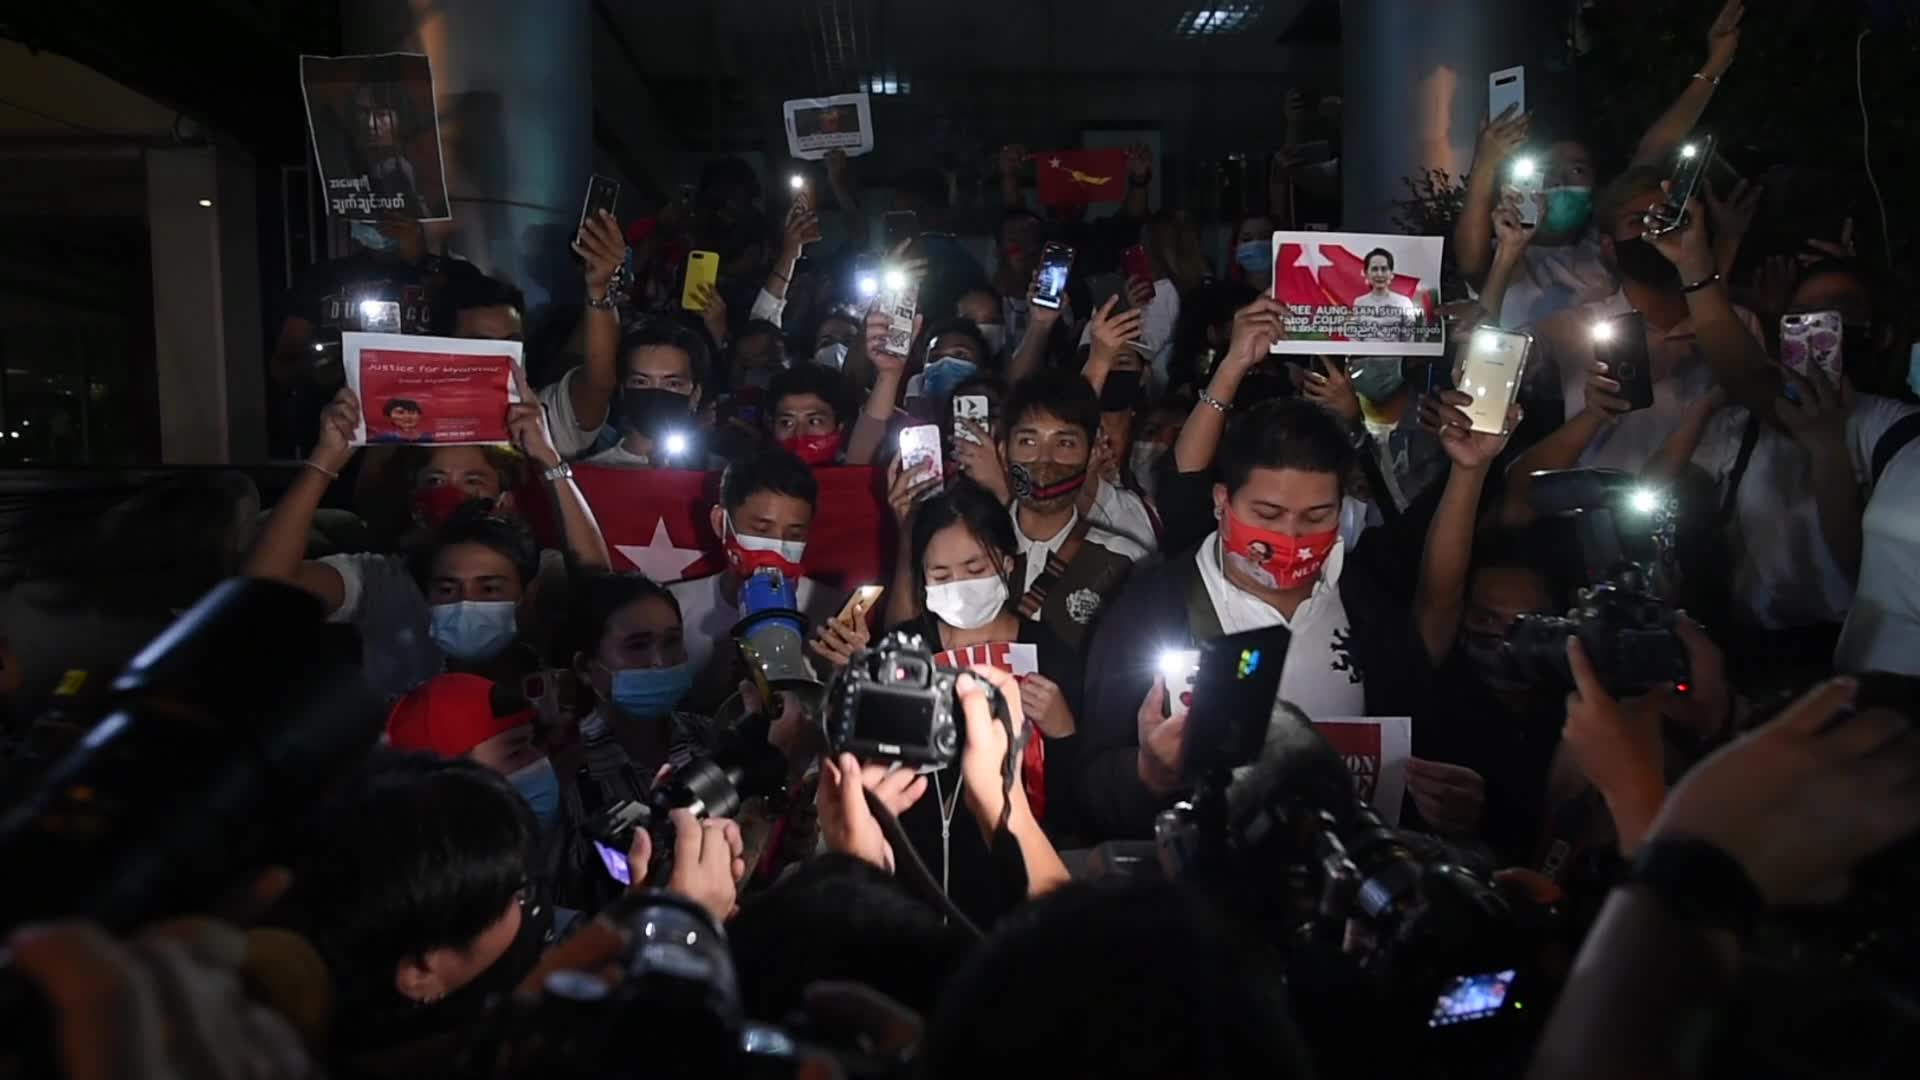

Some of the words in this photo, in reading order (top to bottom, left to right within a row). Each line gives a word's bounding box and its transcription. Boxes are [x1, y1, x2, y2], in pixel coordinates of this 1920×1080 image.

[1316, 305, 1348, 315] AUNG
[1312, 315, 1345, 325] COUP
[368, 362, 415, 373] Justice
[418, 364, 439, 373] for
